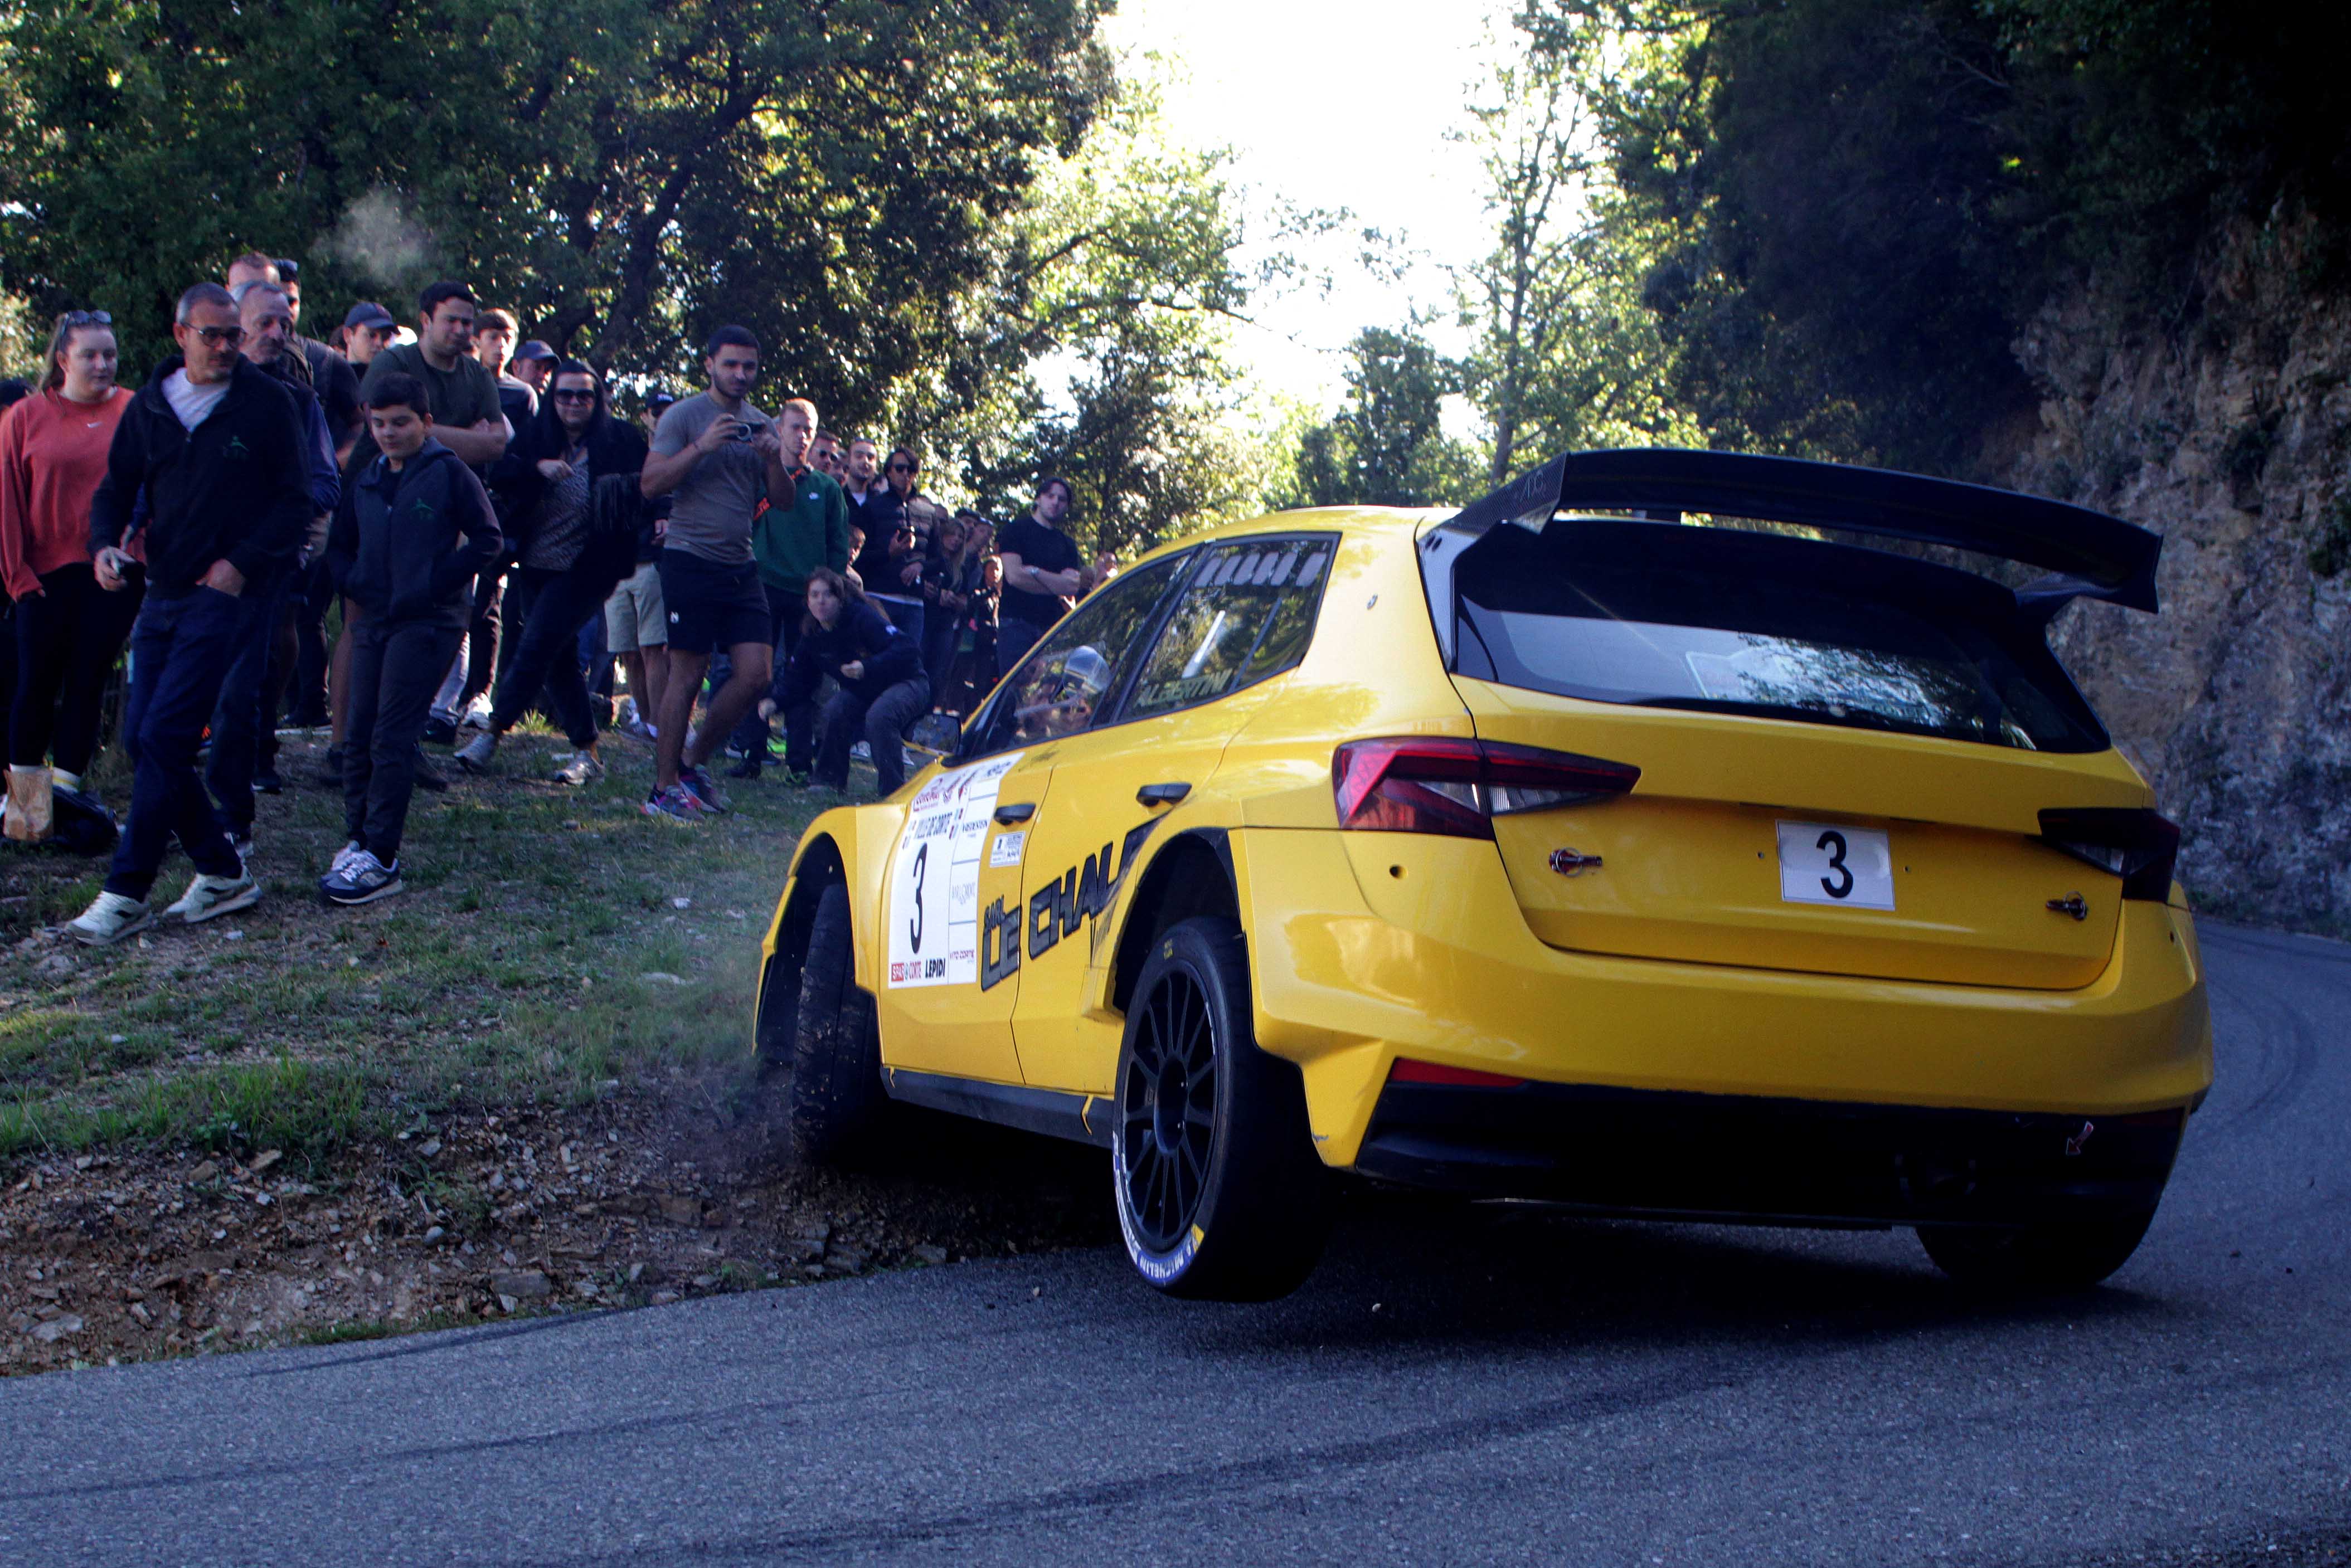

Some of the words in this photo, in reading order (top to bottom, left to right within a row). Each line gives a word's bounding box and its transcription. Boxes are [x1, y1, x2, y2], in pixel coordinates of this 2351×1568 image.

[910, 842, 927, 954] 3
[1816, 830, 1854, 898] 3
[925, 958, 946, 978] LEPIDI
[980, 905, 1022, 992] LE
[1139, 1252, 1184, 1278] MICHELIN
